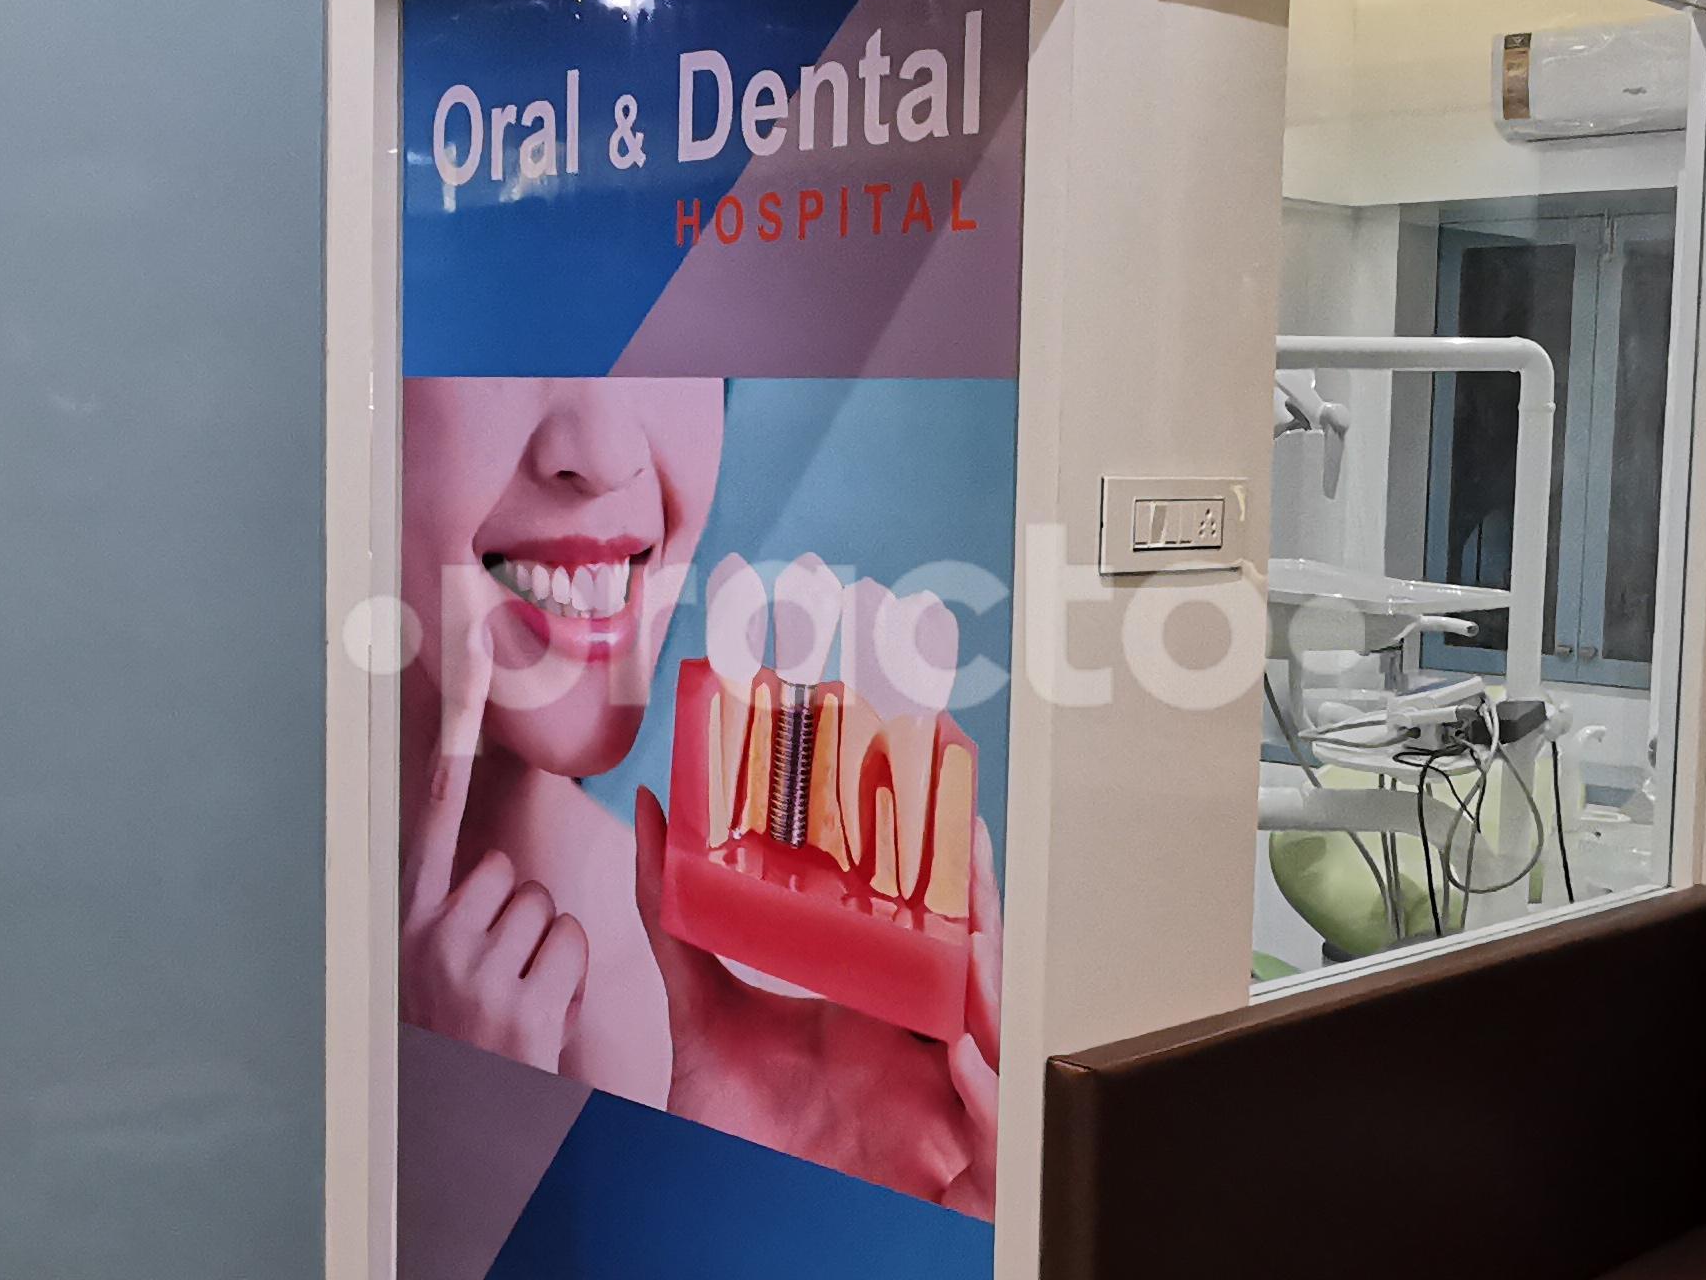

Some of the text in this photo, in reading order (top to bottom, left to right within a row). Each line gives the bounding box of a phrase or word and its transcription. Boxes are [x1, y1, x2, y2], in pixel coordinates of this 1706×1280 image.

[433, 9, 983, 186] Oral & Dental
[676, 178, 978, 247] HOSPITAL
